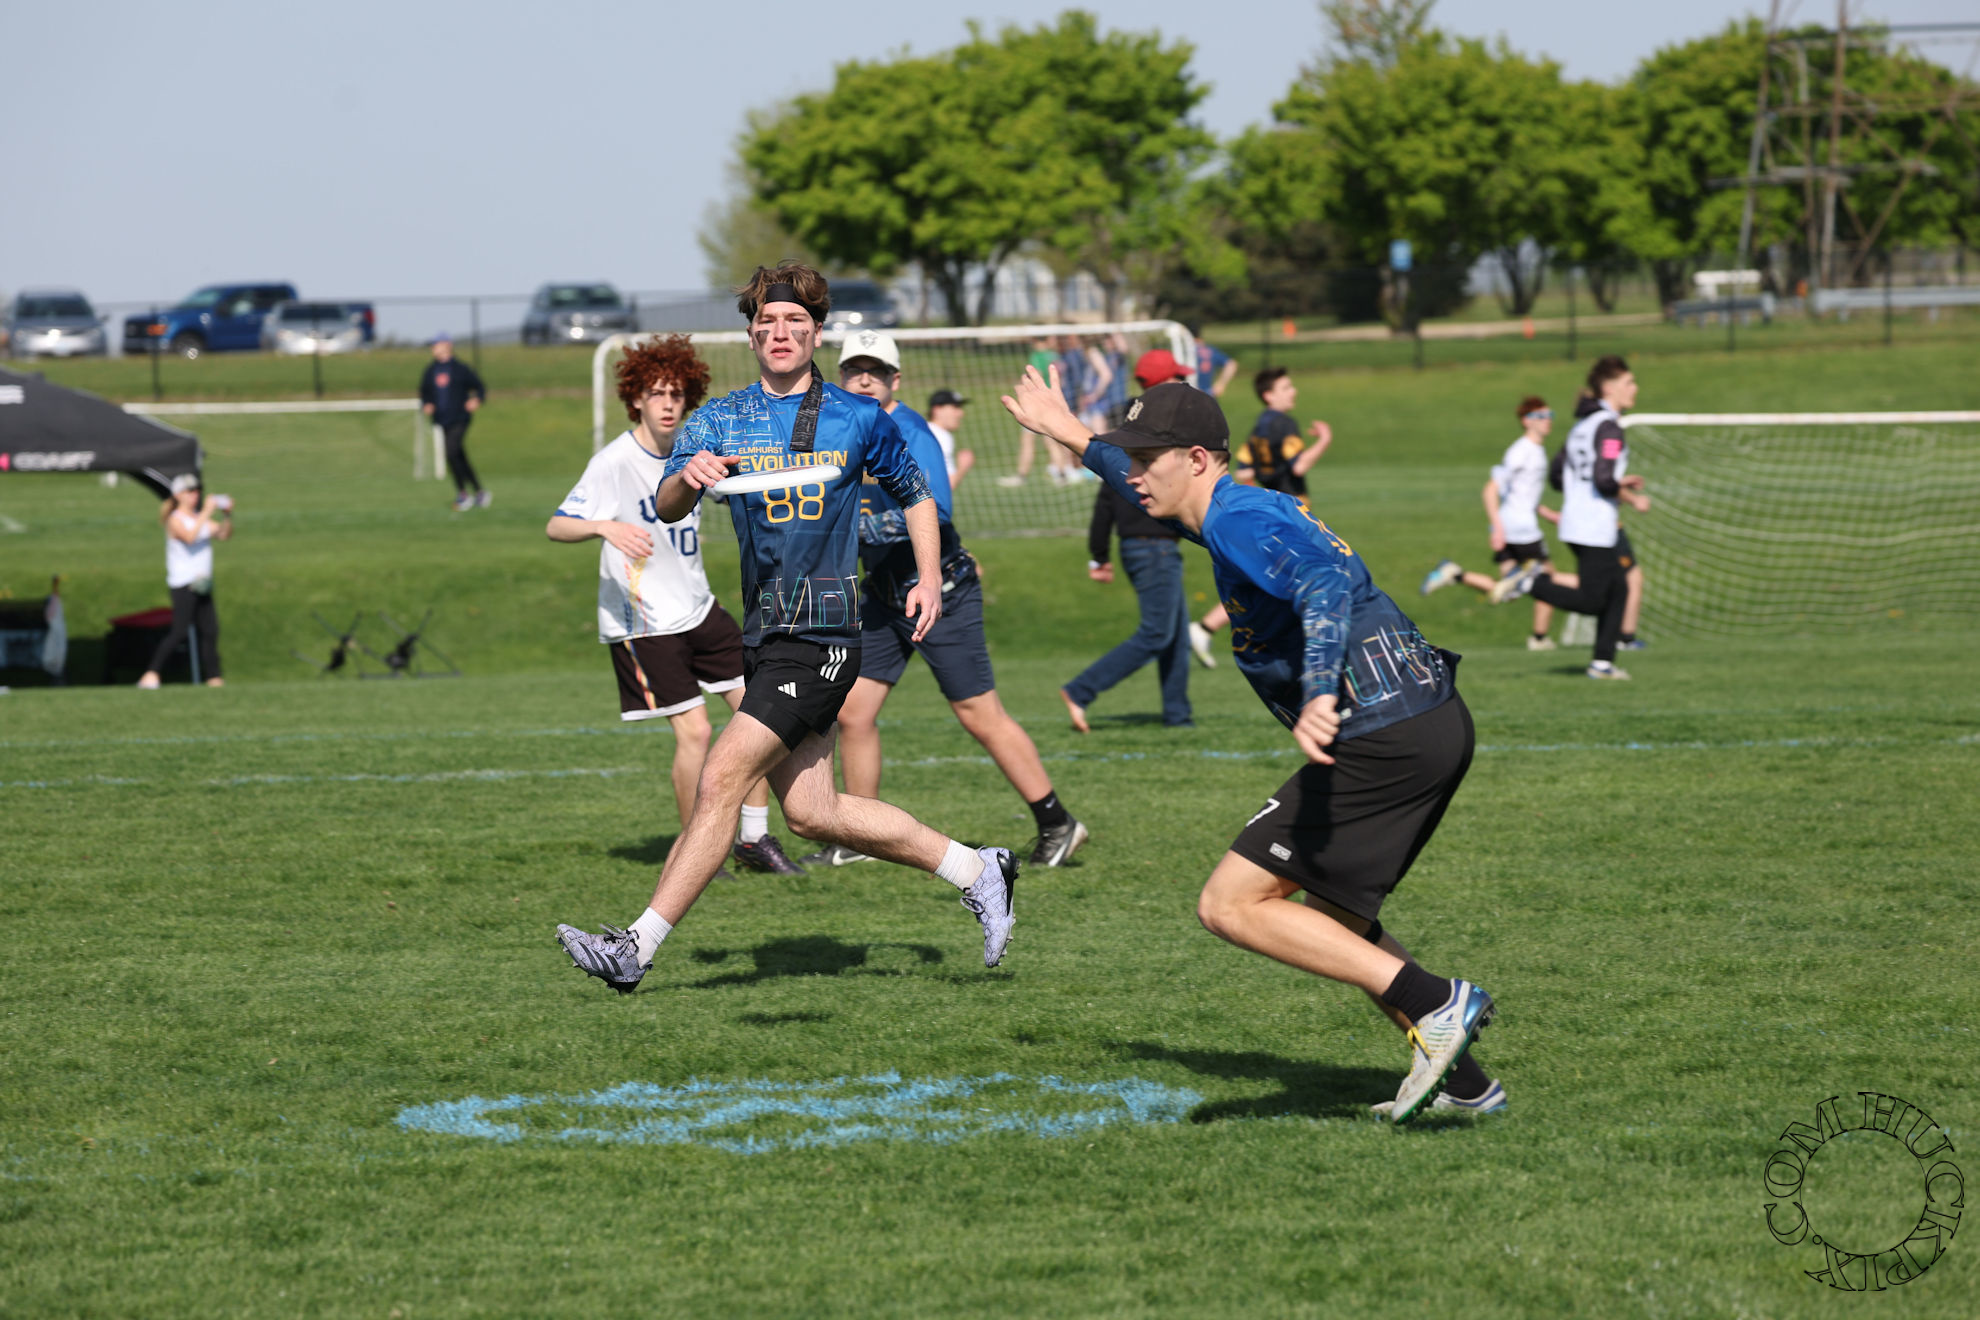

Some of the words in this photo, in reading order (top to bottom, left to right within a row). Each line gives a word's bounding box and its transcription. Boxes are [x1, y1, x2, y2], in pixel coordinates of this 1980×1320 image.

[738, 446, 784, 454] ELMHURST
[738, 450, 848, 472] EVOLUTION
[762, 482, 826, 523] 88
[667, 526, 698, 557] 10
